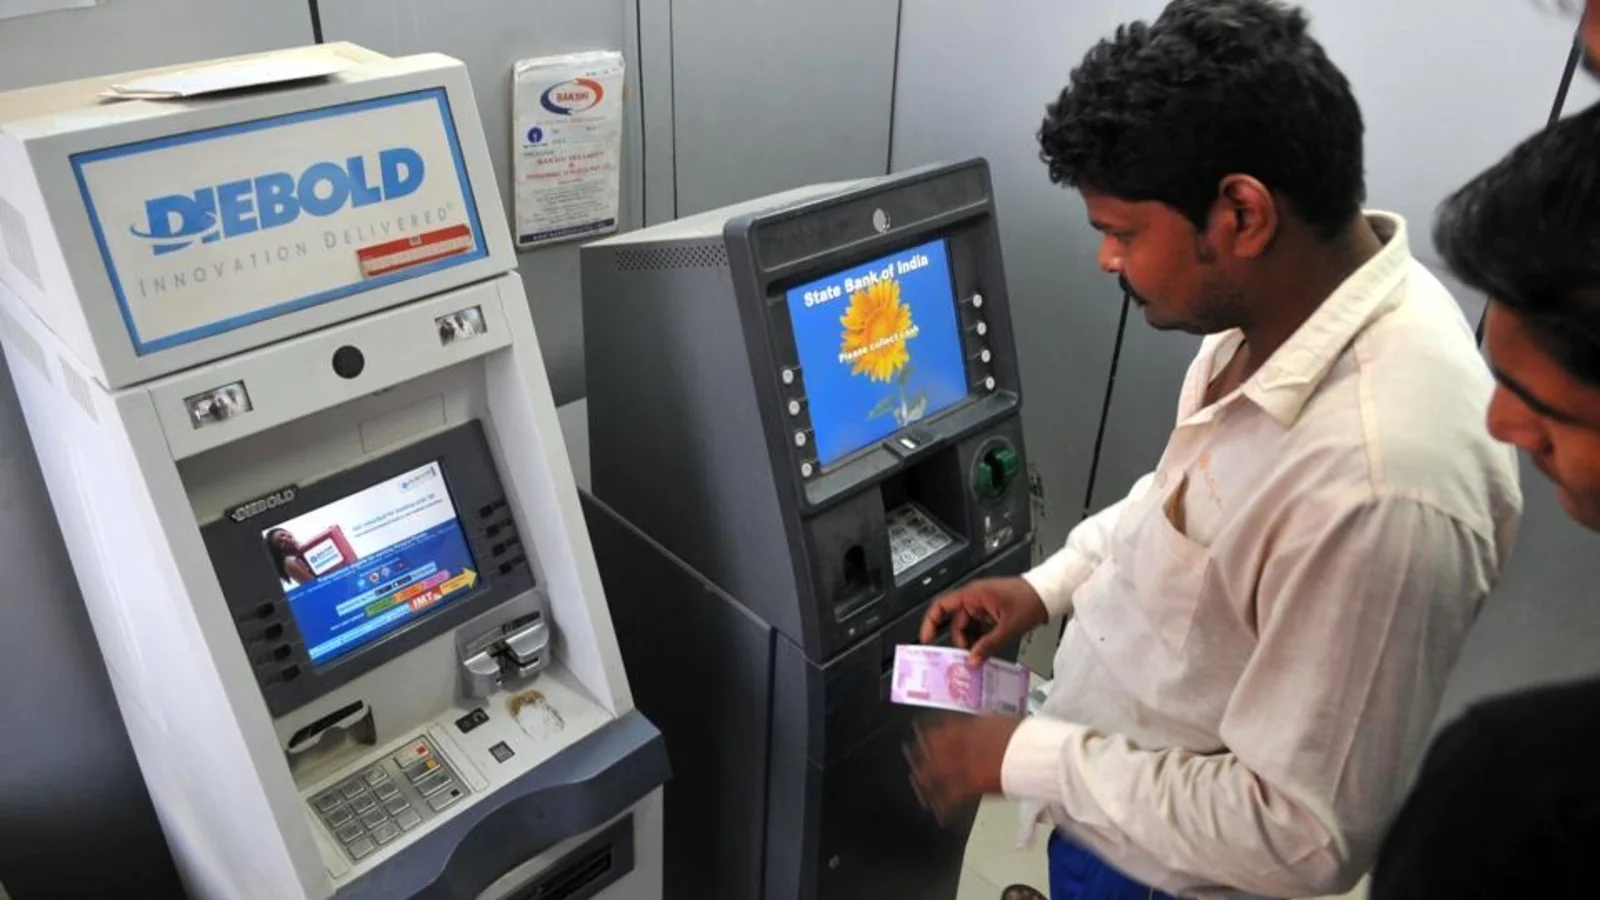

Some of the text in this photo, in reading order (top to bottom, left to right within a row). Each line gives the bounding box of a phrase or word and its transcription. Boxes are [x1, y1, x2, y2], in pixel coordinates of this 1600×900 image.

[143, 147, 425, 255] DIEBOLD
[138, 242, 309, 298] INNOVATION
[323, 208, 449, 250] DELIVERED
[804, 254, 929, 307] State Bank of India
[838, 324, 920, 362] Please collect cash
[233, 488, 295, 522] DIEBOLD
